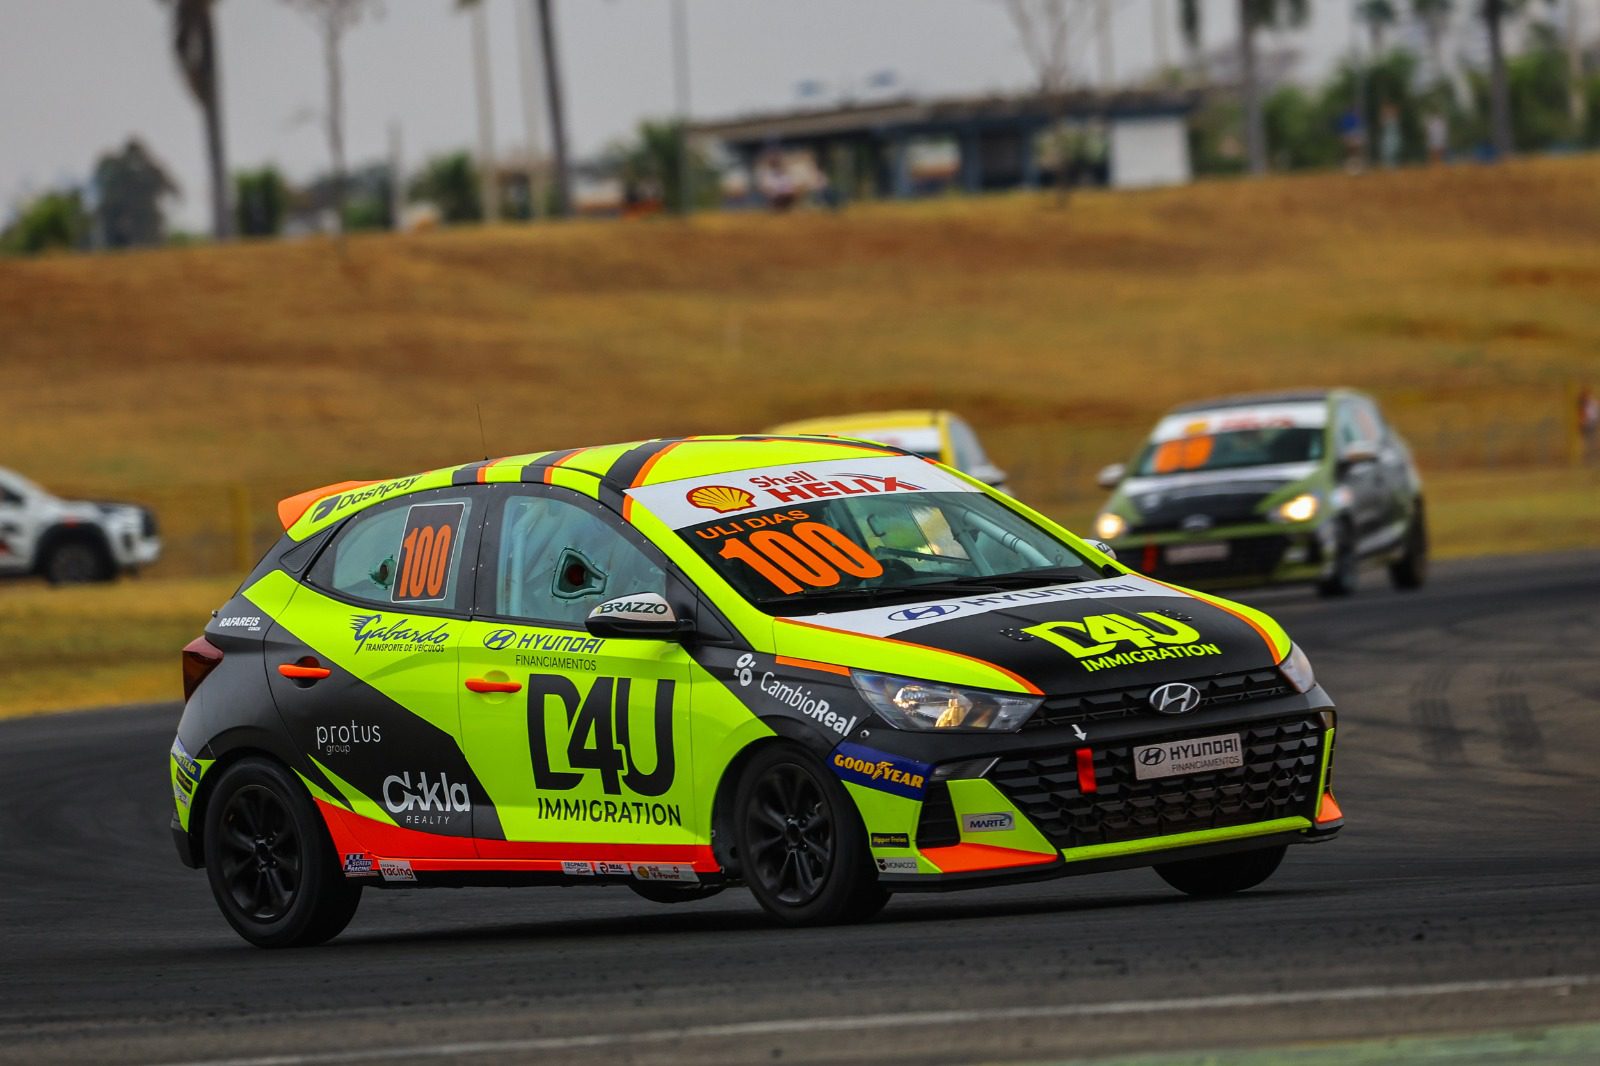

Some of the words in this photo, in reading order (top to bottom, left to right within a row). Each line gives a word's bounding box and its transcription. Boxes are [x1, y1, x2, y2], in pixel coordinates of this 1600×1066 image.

[749, 470, 818, 488] Shell
[762, 477, 925, 503] HELIX
[336, 475, 424, 511] Dashpay
[696, 522, 743, 540] ULI
[743, 509, 810, 530] DIAS
[399, 524, 452, 598] 100
[718, 521, 884, 595] 100
[599, 602, 668, 615] BRAZZO
[962, 584, 1145, 607] HYUNDAI
[219, 616, 261, 627] RAFAREIS
[350, 613, 450, 655] Gabardo
[365, 643, 403, 652] TRANSPORTE
[404, 643, 413, 652] DE
[517, 633, 606, 655] HYUNDAI
[1023, 611, 1201, 659] D4U
[515, 654, 597, 672] FINANCIAMENTOS
[1081, 643, 1222, 672] IMMIGRATION
[760, 671, 858, 737] CambioReal
[315, 719, 382, 750] protus
[526, 673, 676, 797] D4U
[326, 744, 351, 756] group
[1169, 738, 1239, 761] HYUNDAI
[833, 754, 925, 789] GOODYEAR
[1171, 755, 1240, 772] FINANCIAMENTOS
[405, 815, 450, 825] REALTY
[536, 797, 682, 827] IMMIGRATION
[969, 819, 1006, 829] MARTE
